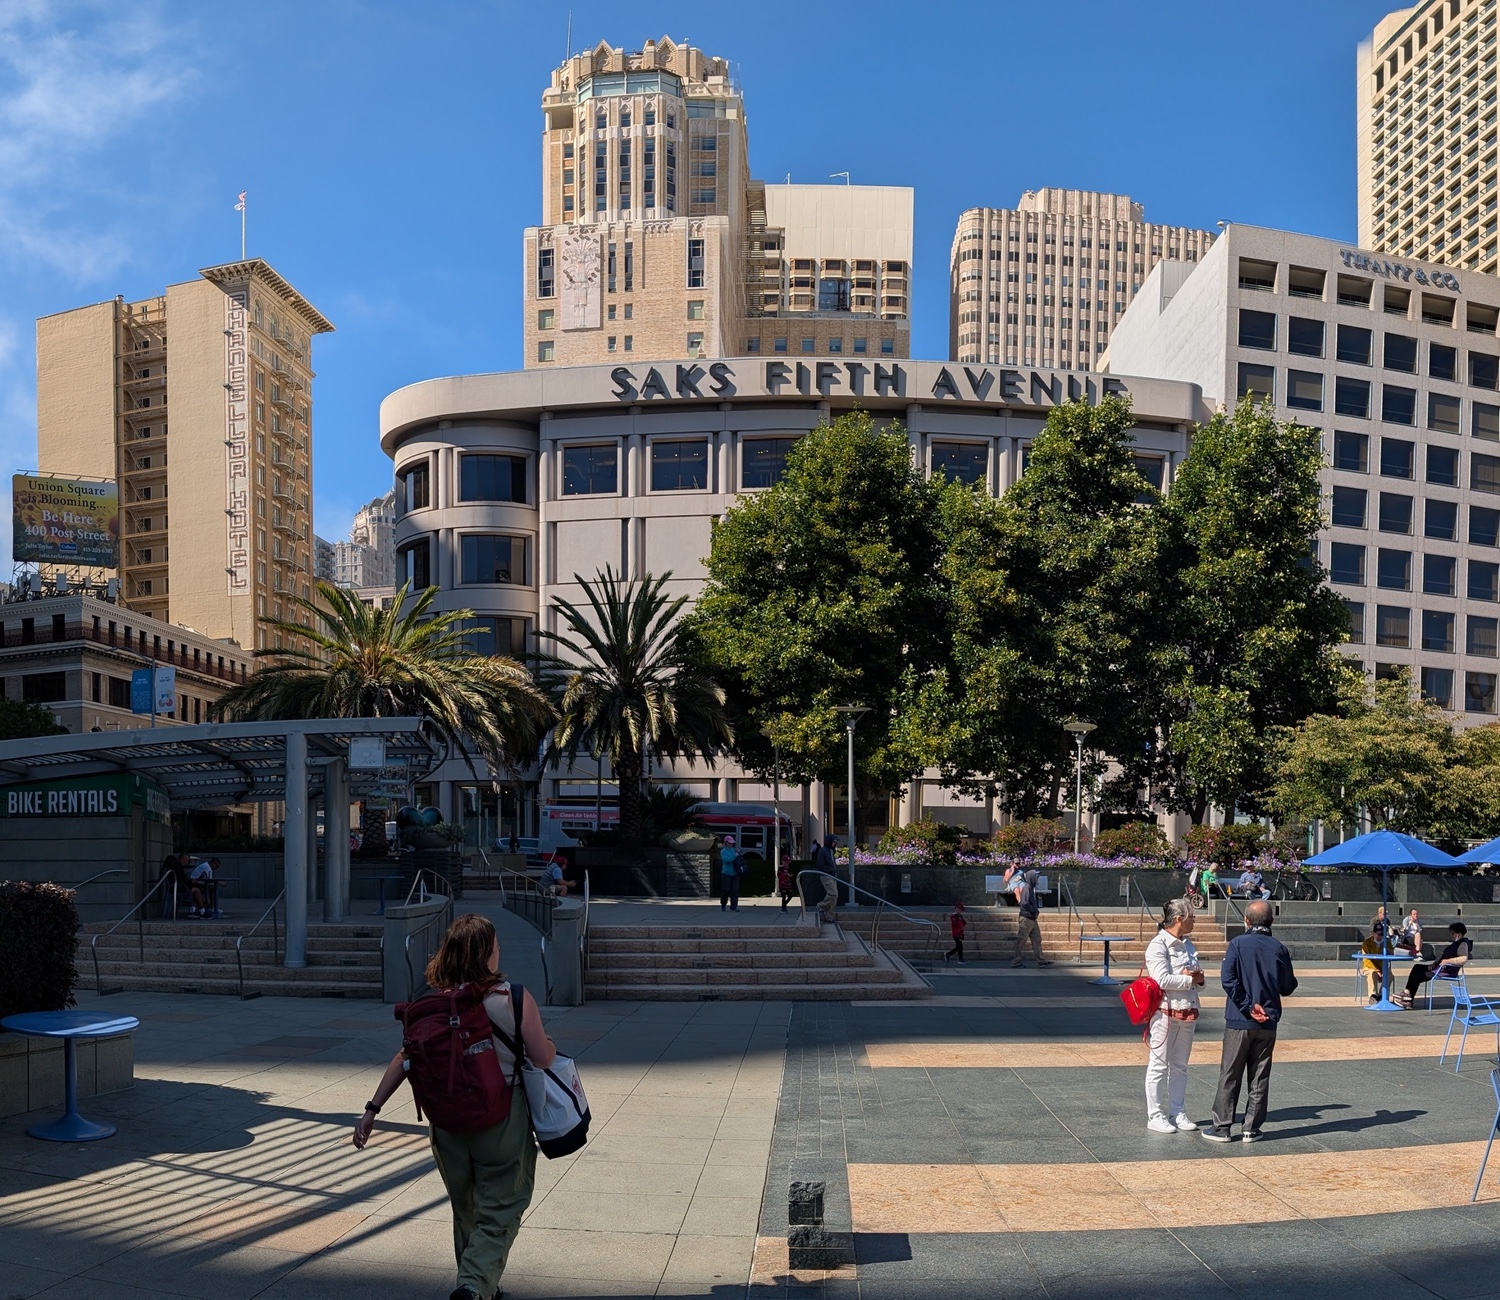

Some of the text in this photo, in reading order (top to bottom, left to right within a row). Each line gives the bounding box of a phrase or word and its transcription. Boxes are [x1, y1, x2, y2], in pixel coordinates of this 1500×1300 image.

[611, 361, 1122, 404] SAKS FIFTH AVENUE
[228, 292, 249, 588] CHANCELLOR HOTEL
[27, 480, 106, 496] Union Square
[27, 493, 106, 511] is Blooming...
[42, 510, 94, 525] Be Here
[25, 525, 110, 541] 400 Post Street
[8, 791, 43, 814] BIKE
[48, 789, 118, 813] RENTALS
